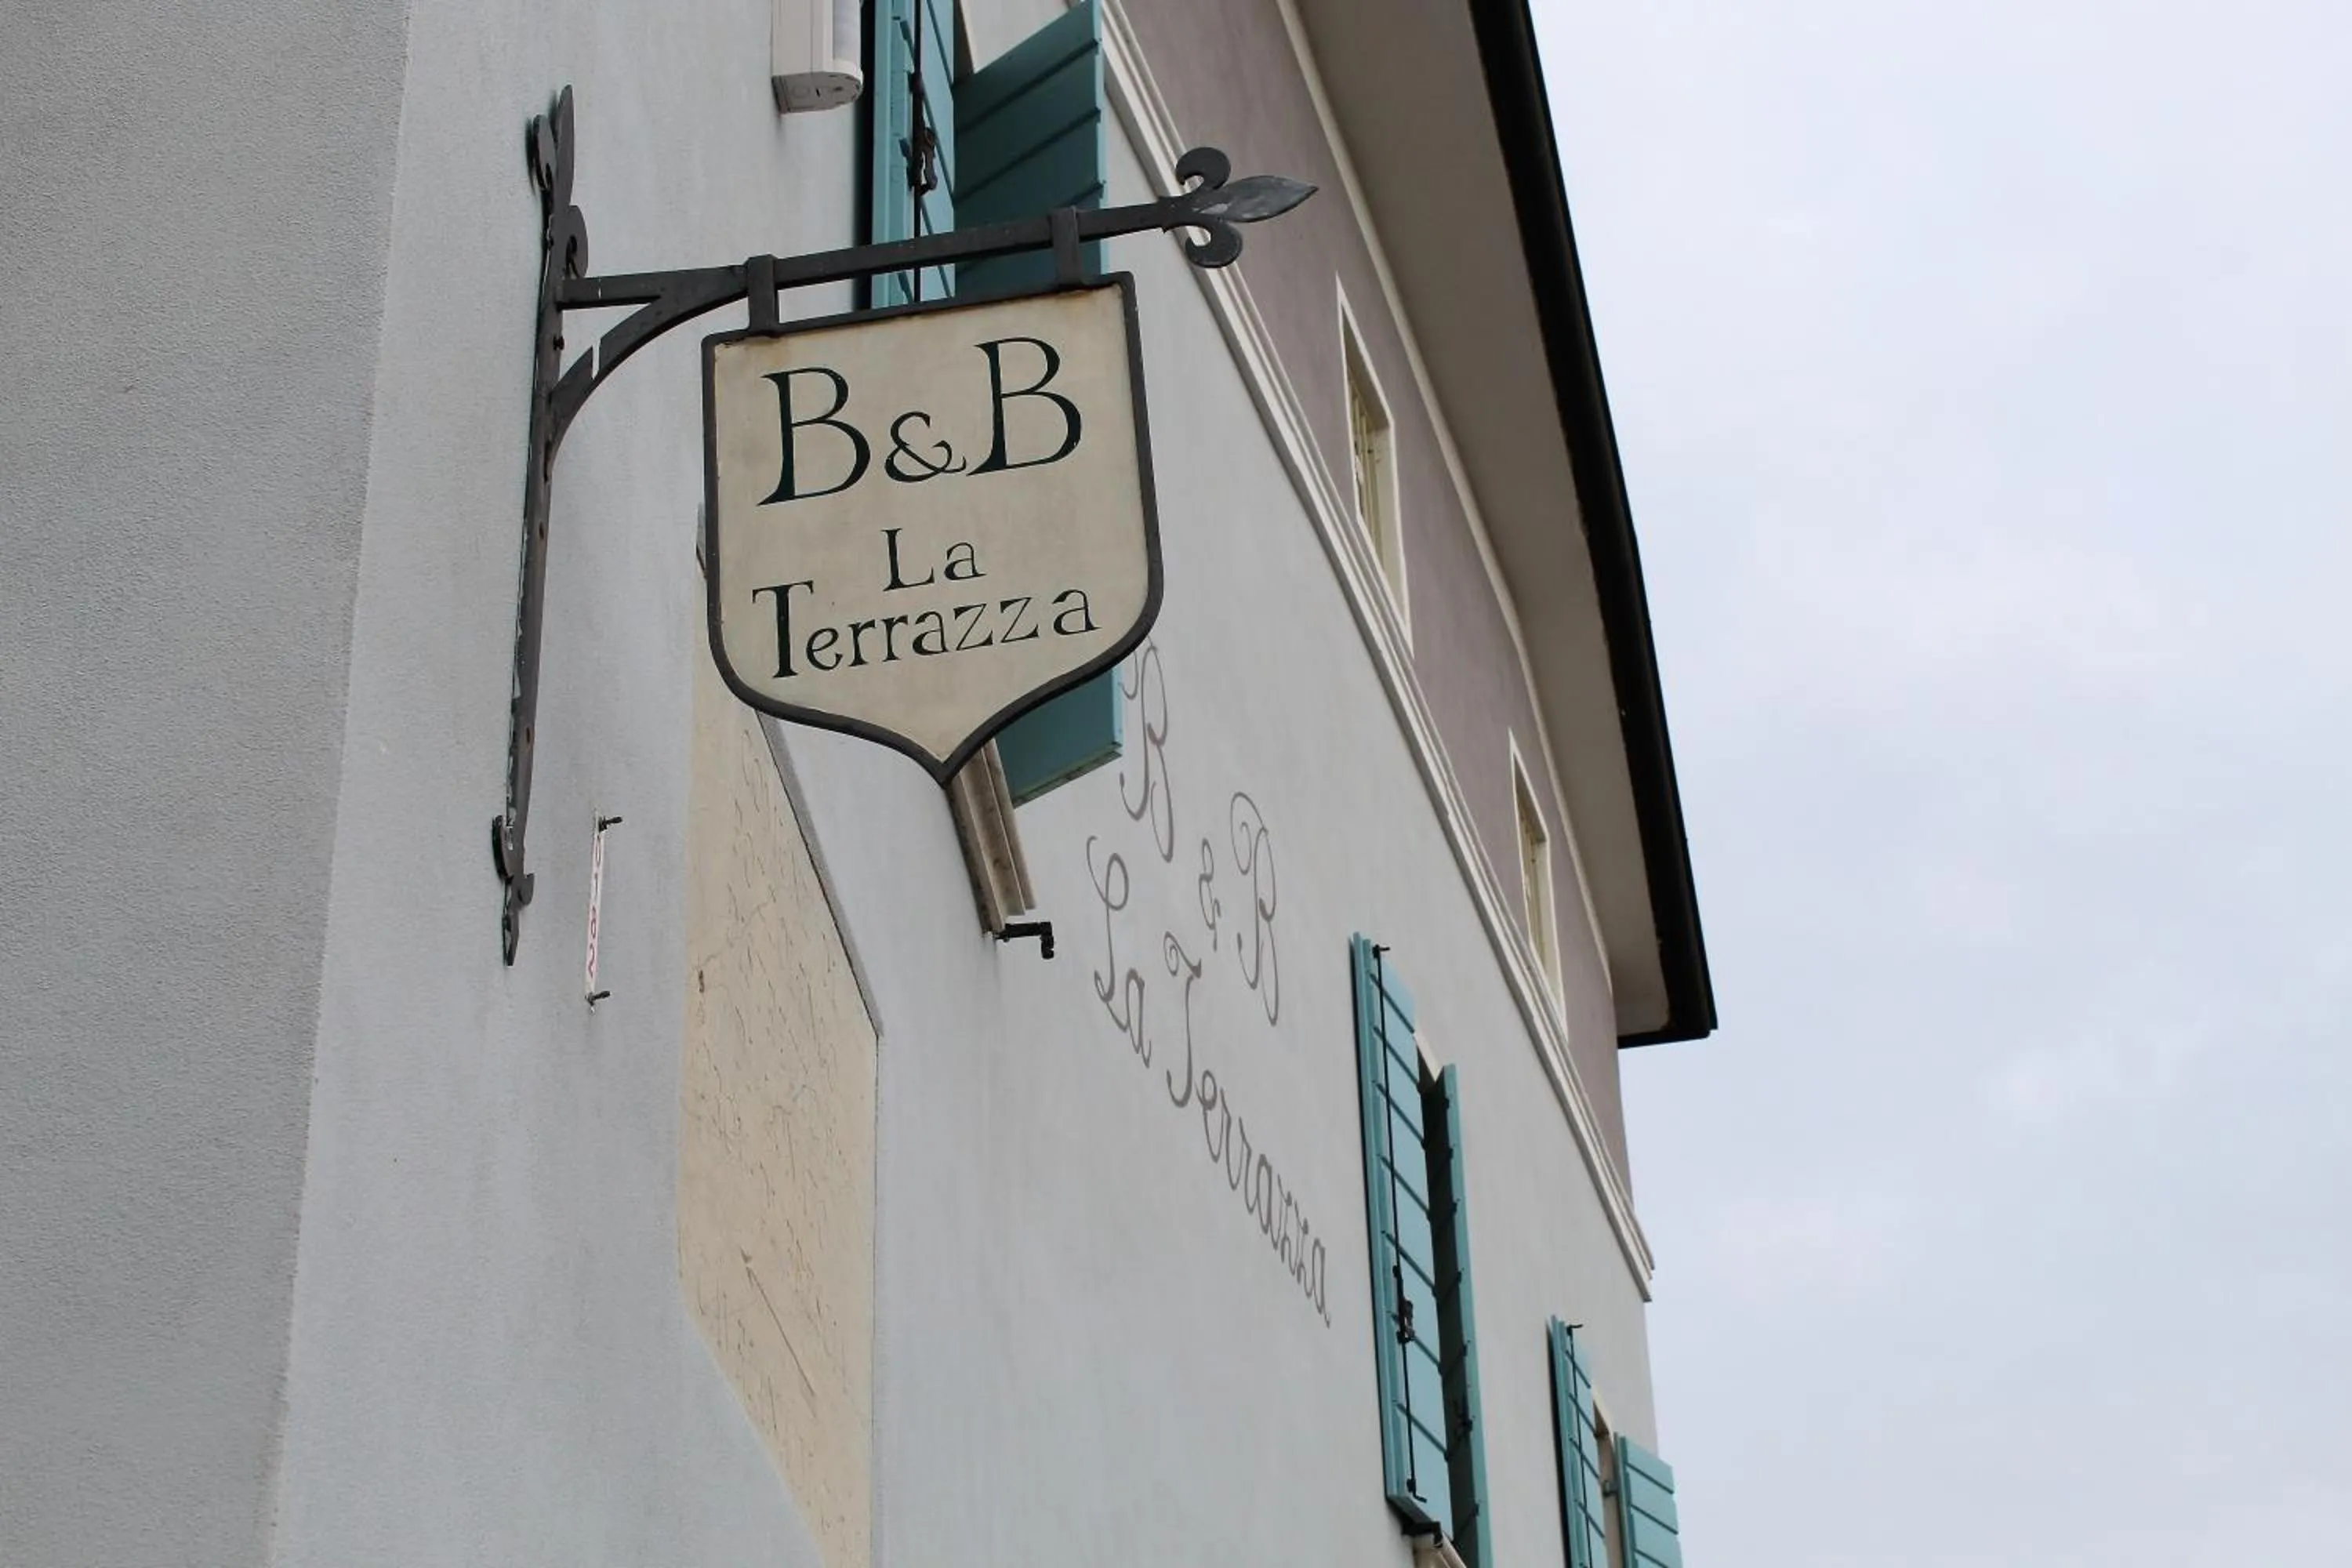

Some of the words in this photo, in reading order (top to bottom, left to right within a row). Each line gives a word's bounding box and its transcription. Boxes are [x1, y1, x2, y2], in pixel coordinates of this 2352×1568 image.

[758, 337, 1082, 506] B&B
[881, 528, 987, 592] La
[752, 579, 1102, 679] Terrazza
[1086, 836, 1152, 1069] La
[1163, 931, 1330, 1329] Terrazza
